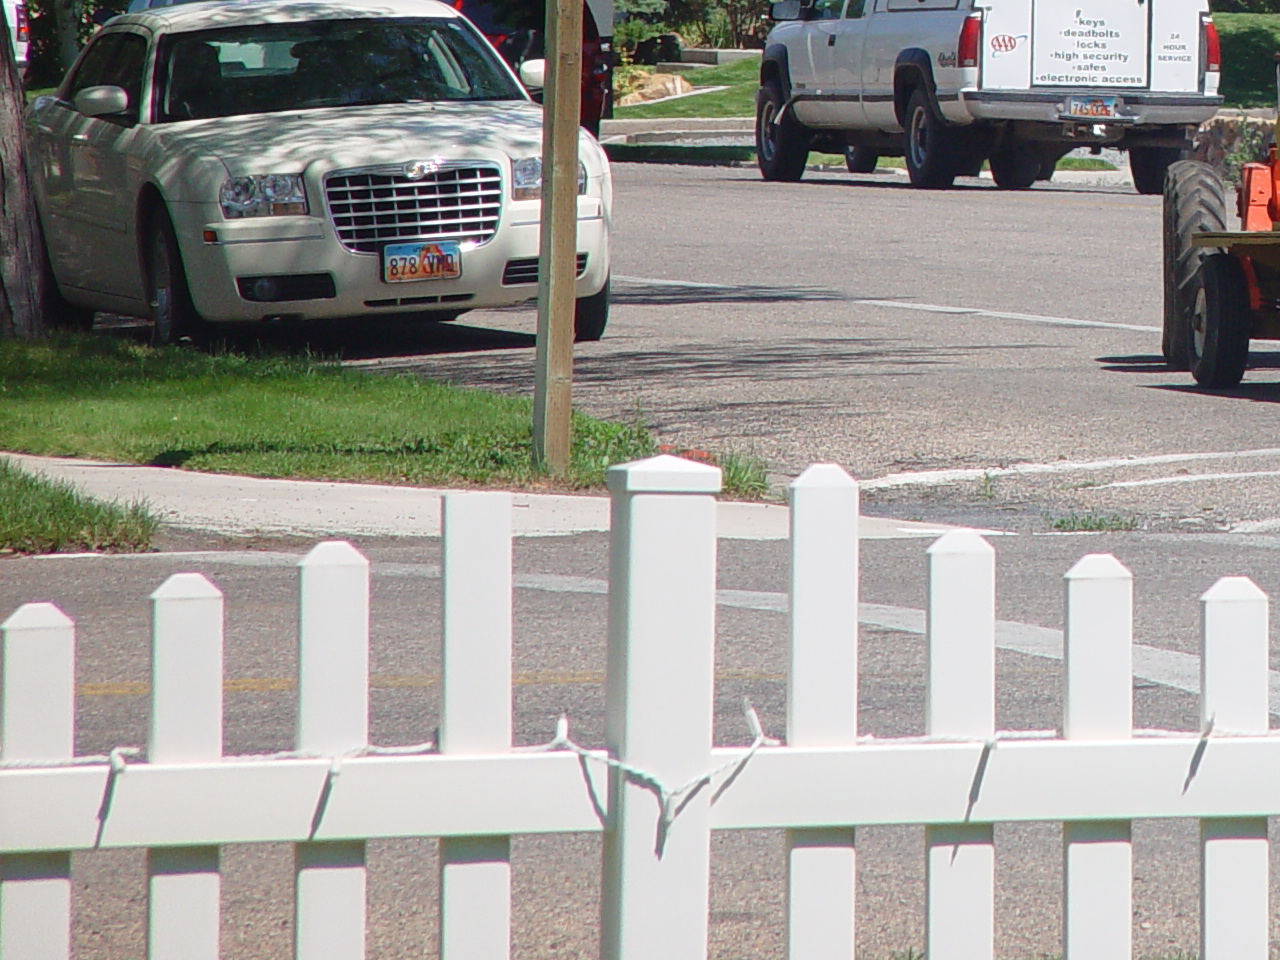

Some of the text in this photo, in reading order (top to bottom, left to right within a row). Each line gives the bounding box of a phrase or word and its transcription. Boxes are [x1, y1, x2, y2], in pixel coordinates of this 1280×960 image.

[1078, 17, 1106, 28] keys
[1063, 28, 1121, 38] deadbolts
[1076, 40, 1107, 49] locks
[1054, 51, 1129, 63] high security
[1076, 63, 1107, 72] safes
[1040, 73, 1098, 83] electronic
[389, 256, 418, 276] 878
